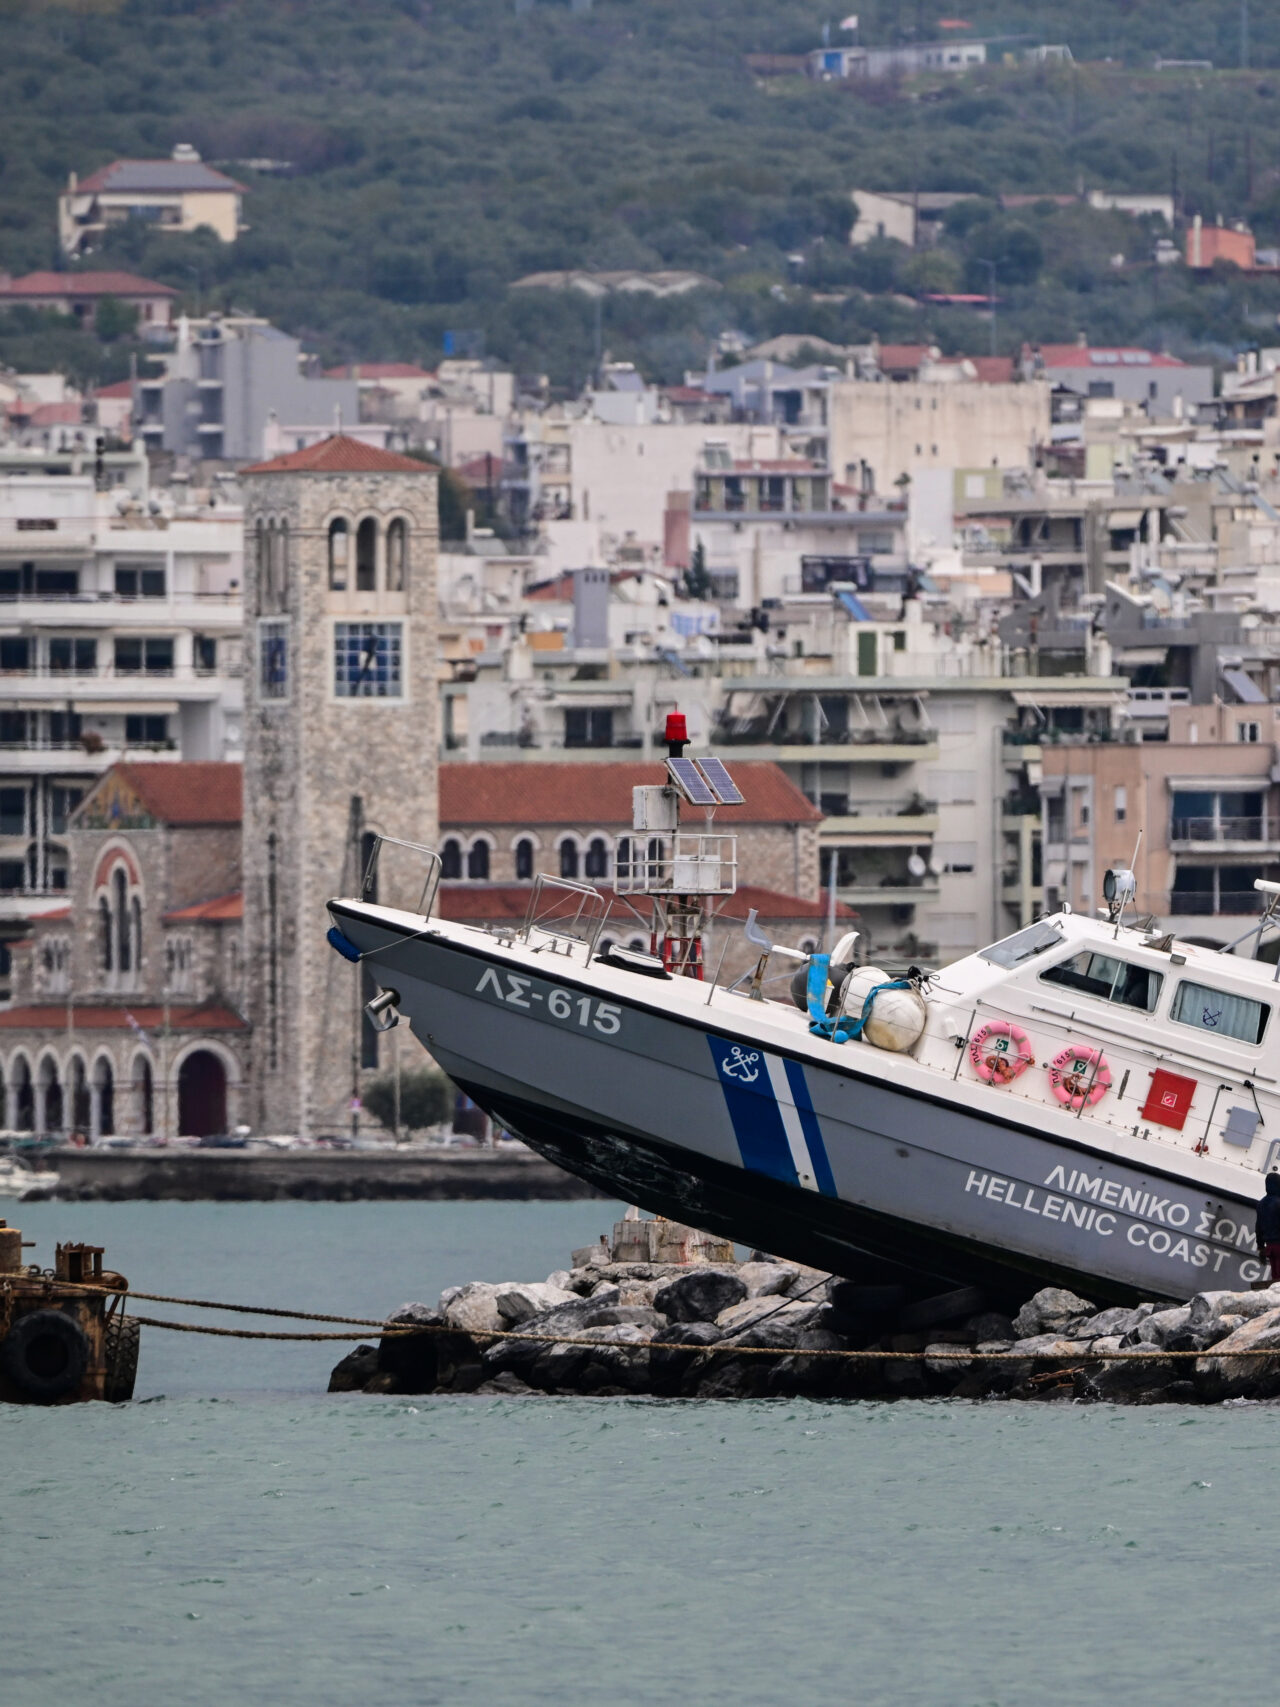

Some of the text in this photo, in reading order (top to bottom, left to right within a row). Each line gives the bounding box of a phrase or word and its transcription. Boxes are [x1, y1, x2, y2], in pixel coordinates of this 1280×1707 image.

[475, 967, 622, 1034] ΛΣ-615
[974, 1029, 987, 1043] 615
[1056, 1051, 1071, 1064] 615
[965, 1170, 1231, 1272] HELLENIC COAST
[1043, 1164, 1258, 1252] ΛΙΜΕΝΙΚΟ ΣΩΜ
